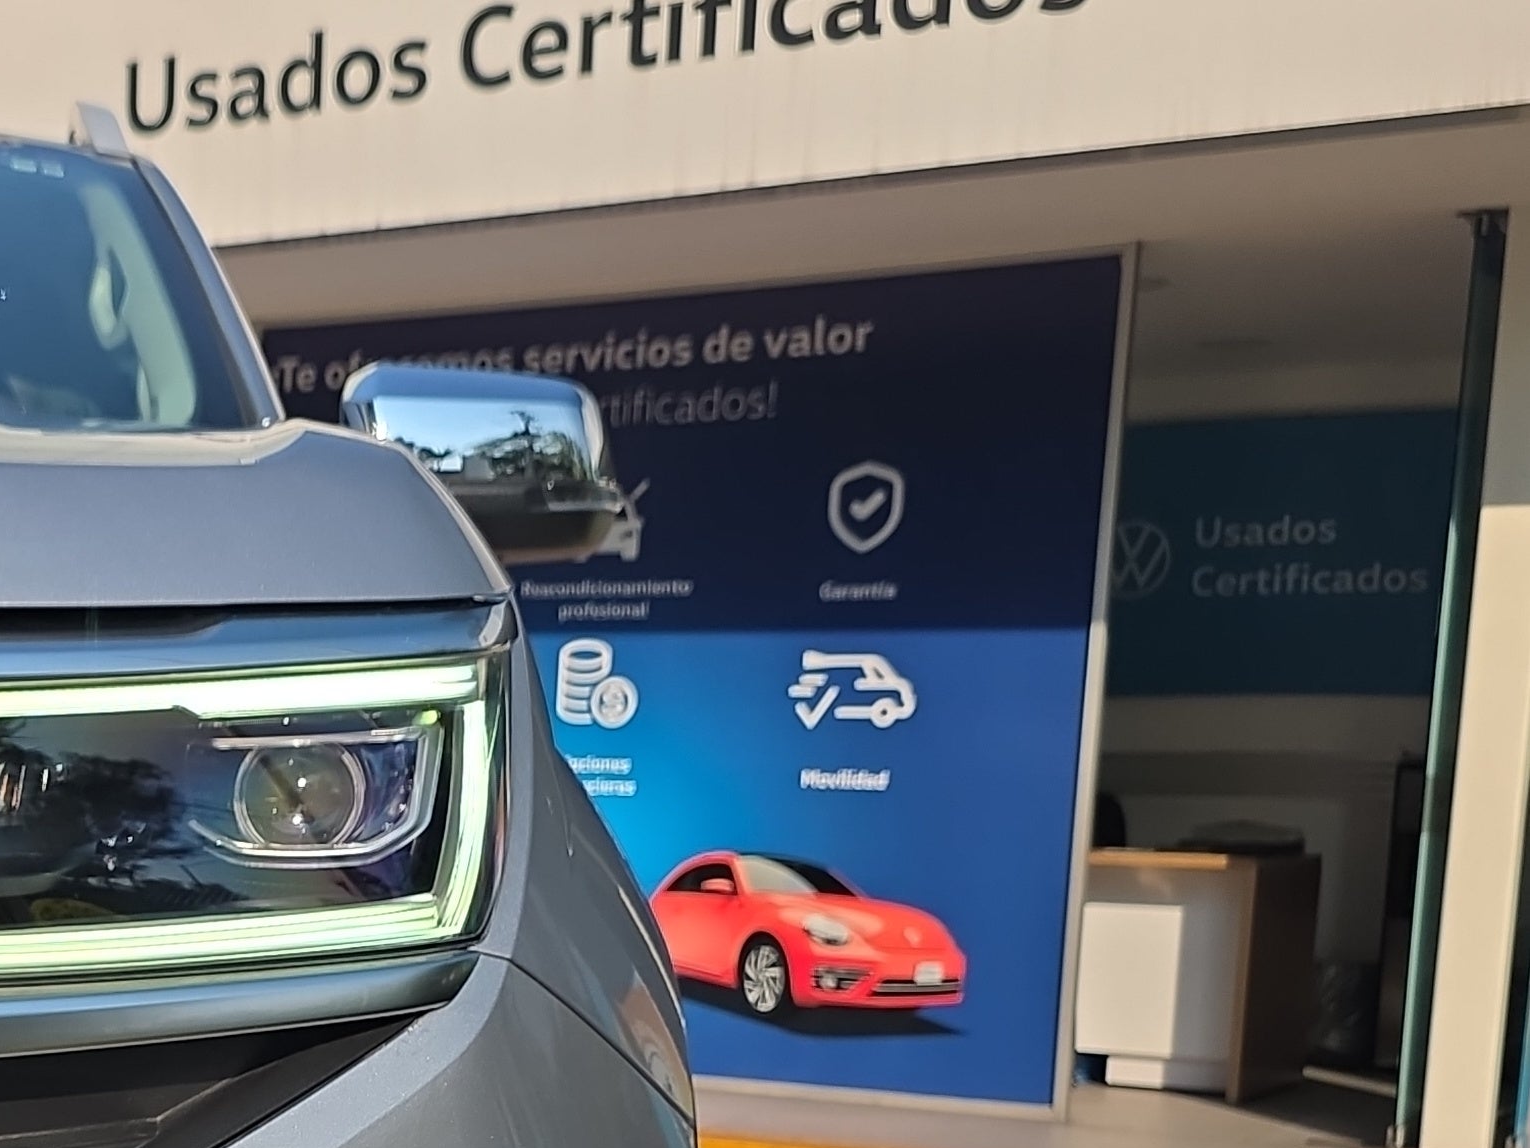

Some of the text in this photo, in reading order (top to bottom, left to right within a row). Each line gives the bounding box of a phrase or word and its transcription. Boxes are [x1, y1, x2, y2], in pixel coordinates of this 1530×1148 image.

[126, 0, 1087, 133] Usados Certifica
[523, 326, 694, 373] servicios
[702, 322, 754, 364] de
[764, 313, 875, 360] valor
[1195, 514, 1338, 549] Usados
[1191, 562, 1429, 598] Certificados
[800, 768, 890, 791] Movilidad
